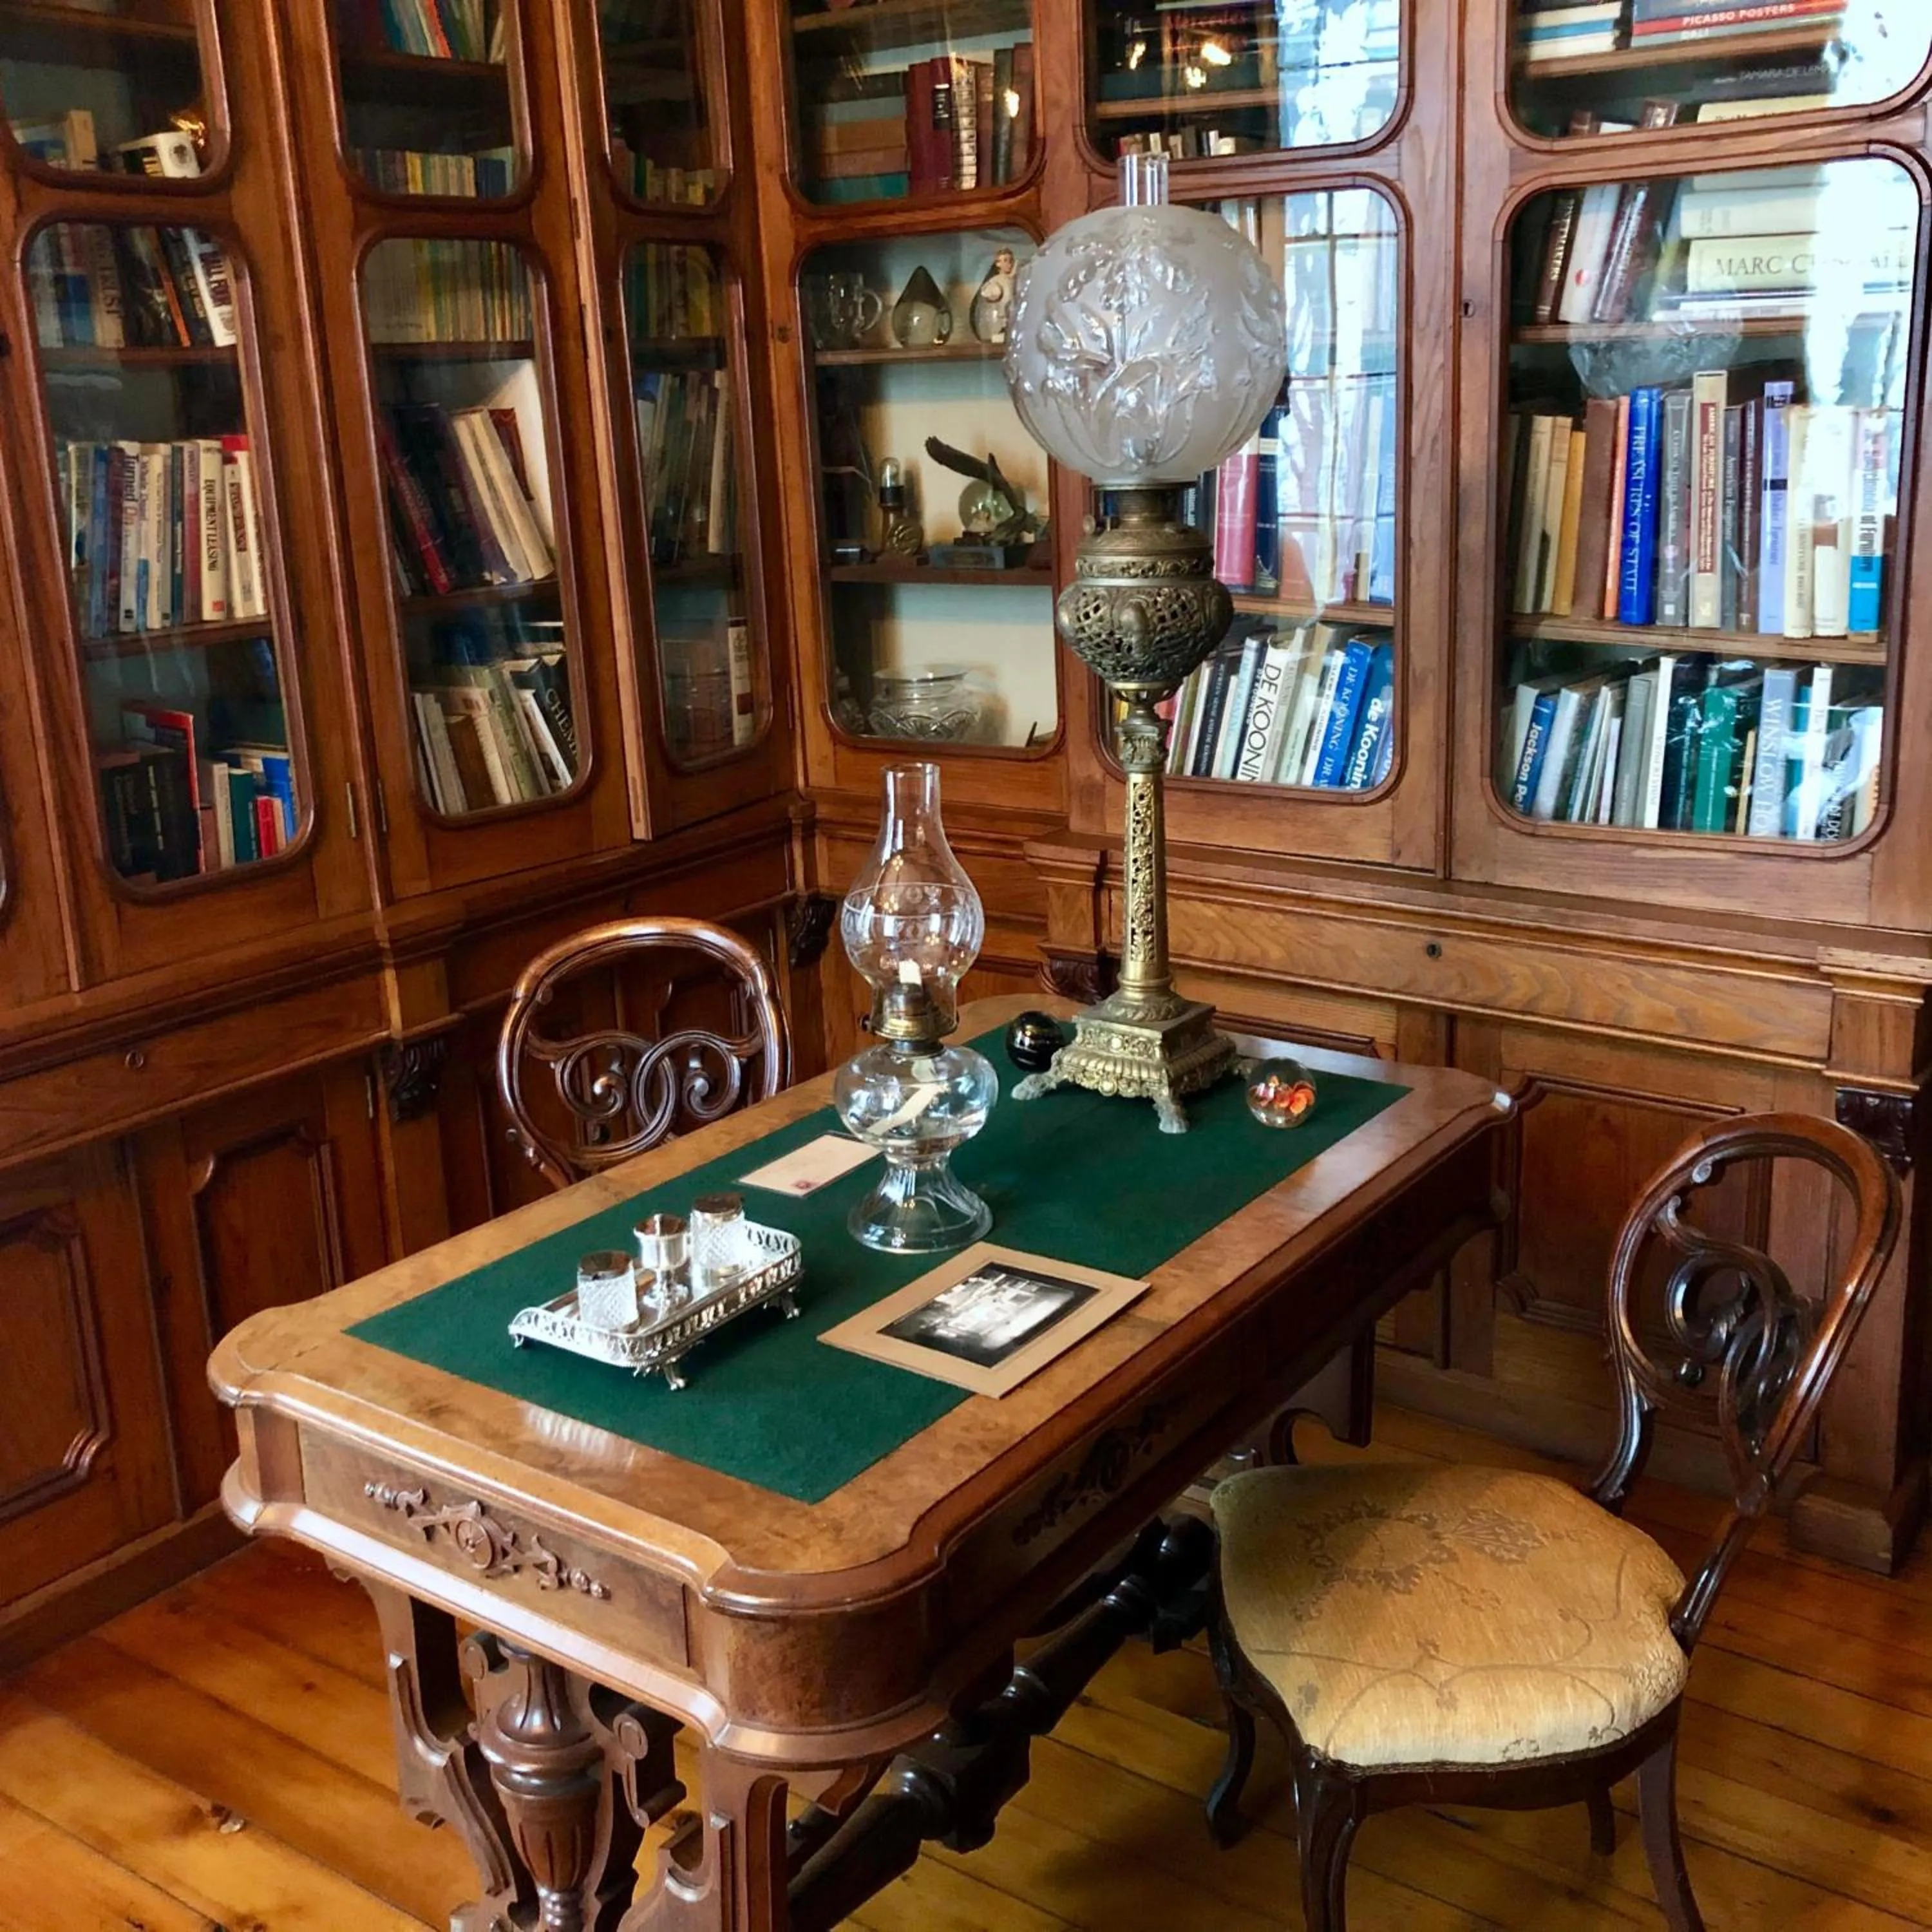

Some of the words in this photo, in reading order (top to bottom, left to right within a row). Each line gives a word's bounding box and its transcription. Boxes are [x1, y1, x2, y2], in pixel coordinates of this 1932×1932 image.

[1682, 12, 1735, 26] PICASSO
[1739, 4, 1795, 19] POSTERS
[1716, 256, 1782, 277] MARC
[124, 455, 140, 502] Turned
[1630, 426, 1647, 516] TREASURES
[1725, 455, 1737, 497] American
[202, 478, 217, 531] EQUIPMENT
[1861, 515, 1877, 525] of
[207, 533, 219, 571] LEASING
[1627, 522, 1641, 544] OF
[1858, 527, 1877, 573] Furniture
[1624, 547, 1639, 596] STATE
[1264, 664, 1282, 695] DE
[1347, 667, 1359, 688] DE
[546, 688, 577, 755] CHEM
[1329, 687, 1353, 751] KOONING
[1367, 697, 1384, 719] de
[1520, 722, 1543, 782] Jackson
[1757, 698, 1783, 791] WINSLOW
